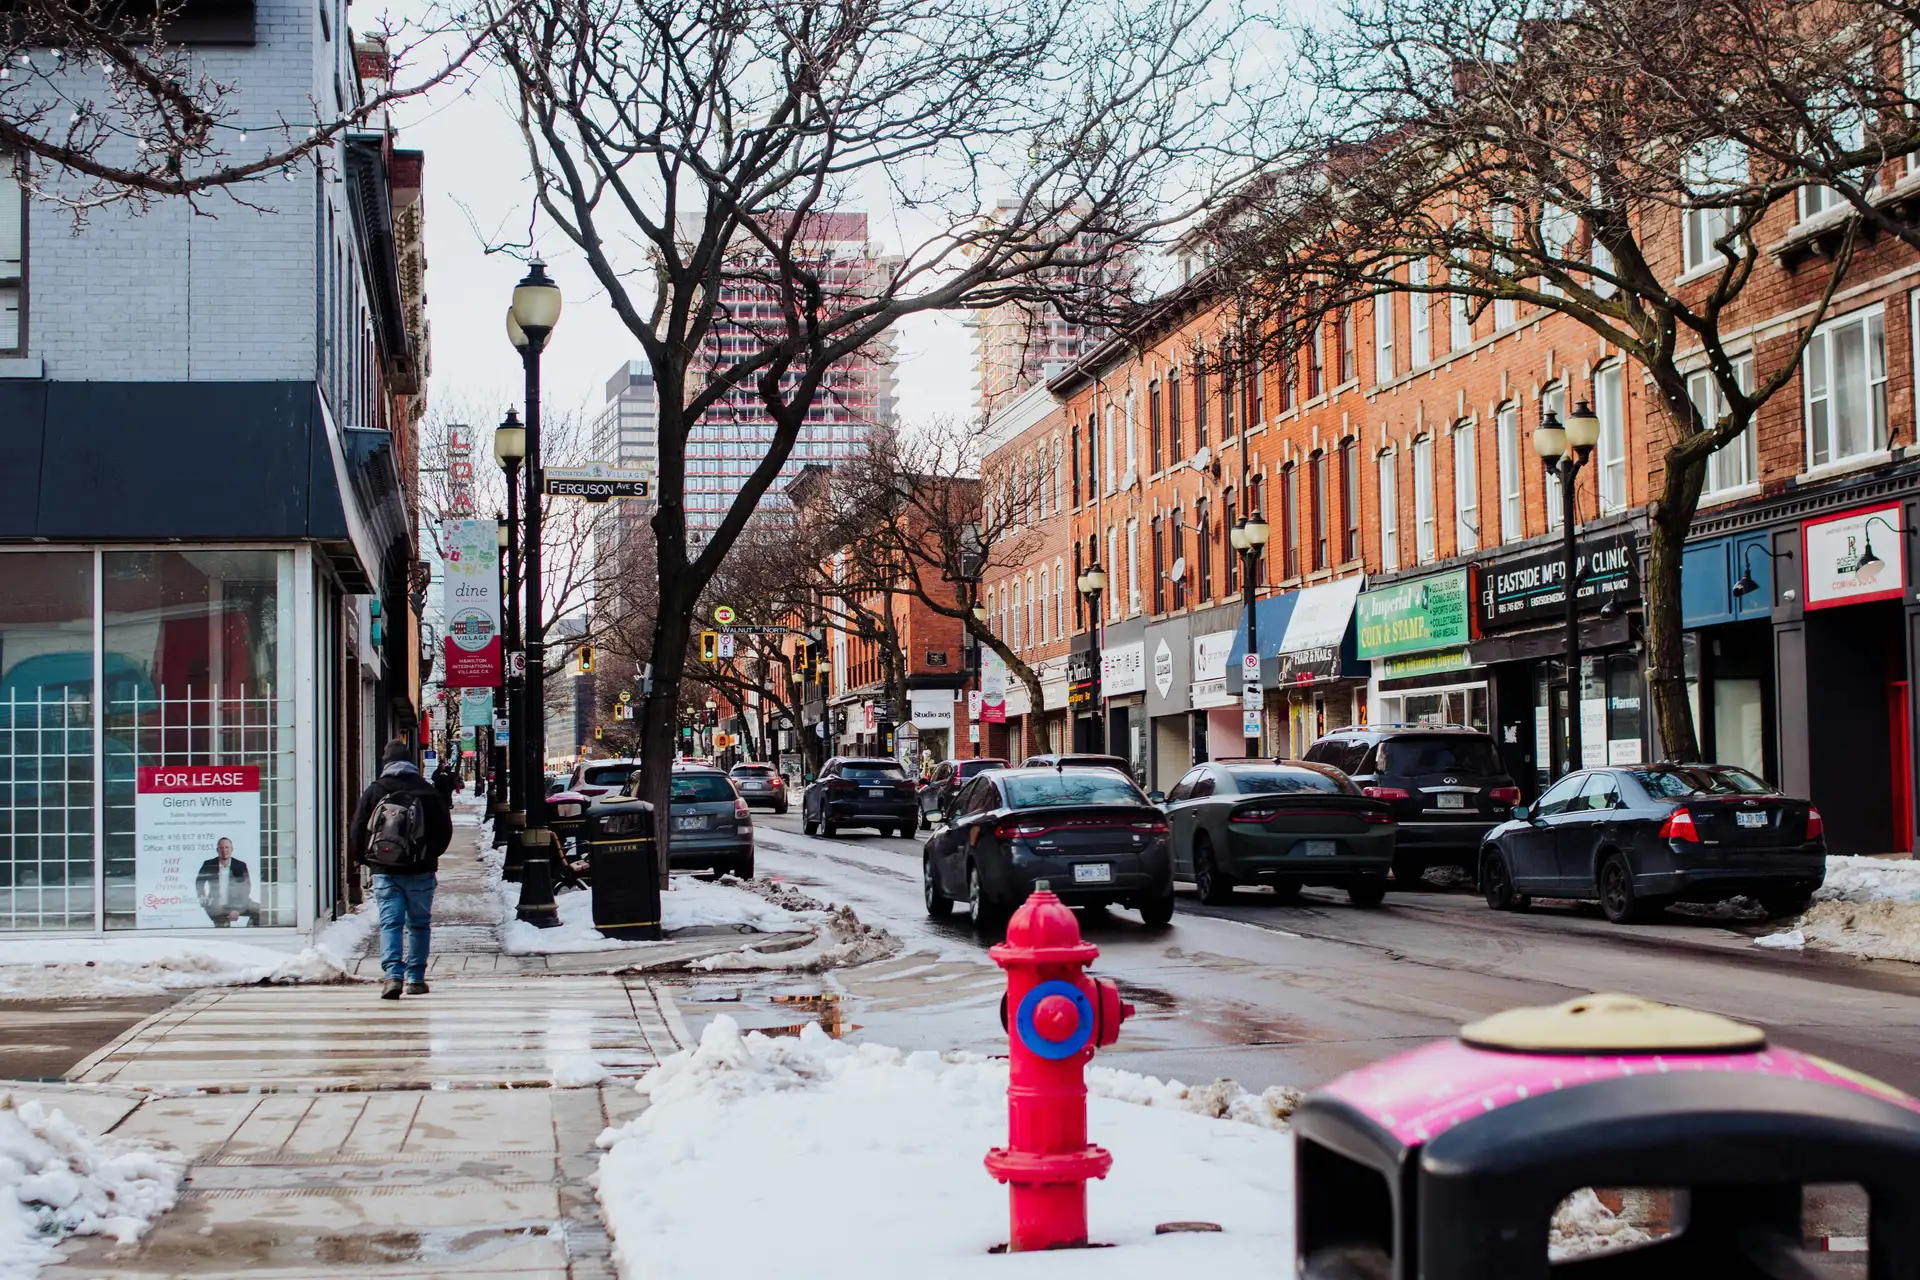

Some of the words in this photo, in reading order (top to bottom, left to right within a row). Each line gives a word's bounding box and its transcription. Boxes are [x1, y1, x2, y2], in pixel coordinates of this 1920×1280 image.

[550, 481, 614, 495] FERGUSON
[633, 483, 644, 495] S
[1498, 566, 1540, 594] EASTSIDE
[1542, 556, 1586, 584] MEDA
[1592, 546, 1629, 573] CLINIC
[455, 582, 488, 597] dine
[1832, 579, 1857, 590] COMING
[1371, 588, 1412, 620] Imperial
[1433, 594, 1446, 605] COMIC
[1446, 591, 1460, 602] BOOKS
[1433, 605, 1449, 616] SPORTS
[1361, 624, 1383, 649] COIN
[1384, 623, 1391, 643] &
[1393, 616, 1424, 642] STAMP
[1433, 629, 1442, 639] WAR
[1443, 626, 1459, 637] MEDALS
[1294, 650, 1309, 665] HAIR
[1315, 648, 1332, 662] NAILS
[1392, 660, 1405, 672] The
[1406, 656, 1436, 671] Ultimate
[1437, 652, 1462, 669] Buyers
[1613, 696, 1640, 710] Pharmacy
[938, 711, 951, 719] 205
[155, 773, 188, 787] FOR
[192, 772, 244, 786] LEASE
[162, 796, 197, 808] Glenn
[200, 796, 233, 807] White
[167, 833, 181, 841] 416
[163, 857, 180, 865] NOT
[162, 866, 179, 874] LIKE
